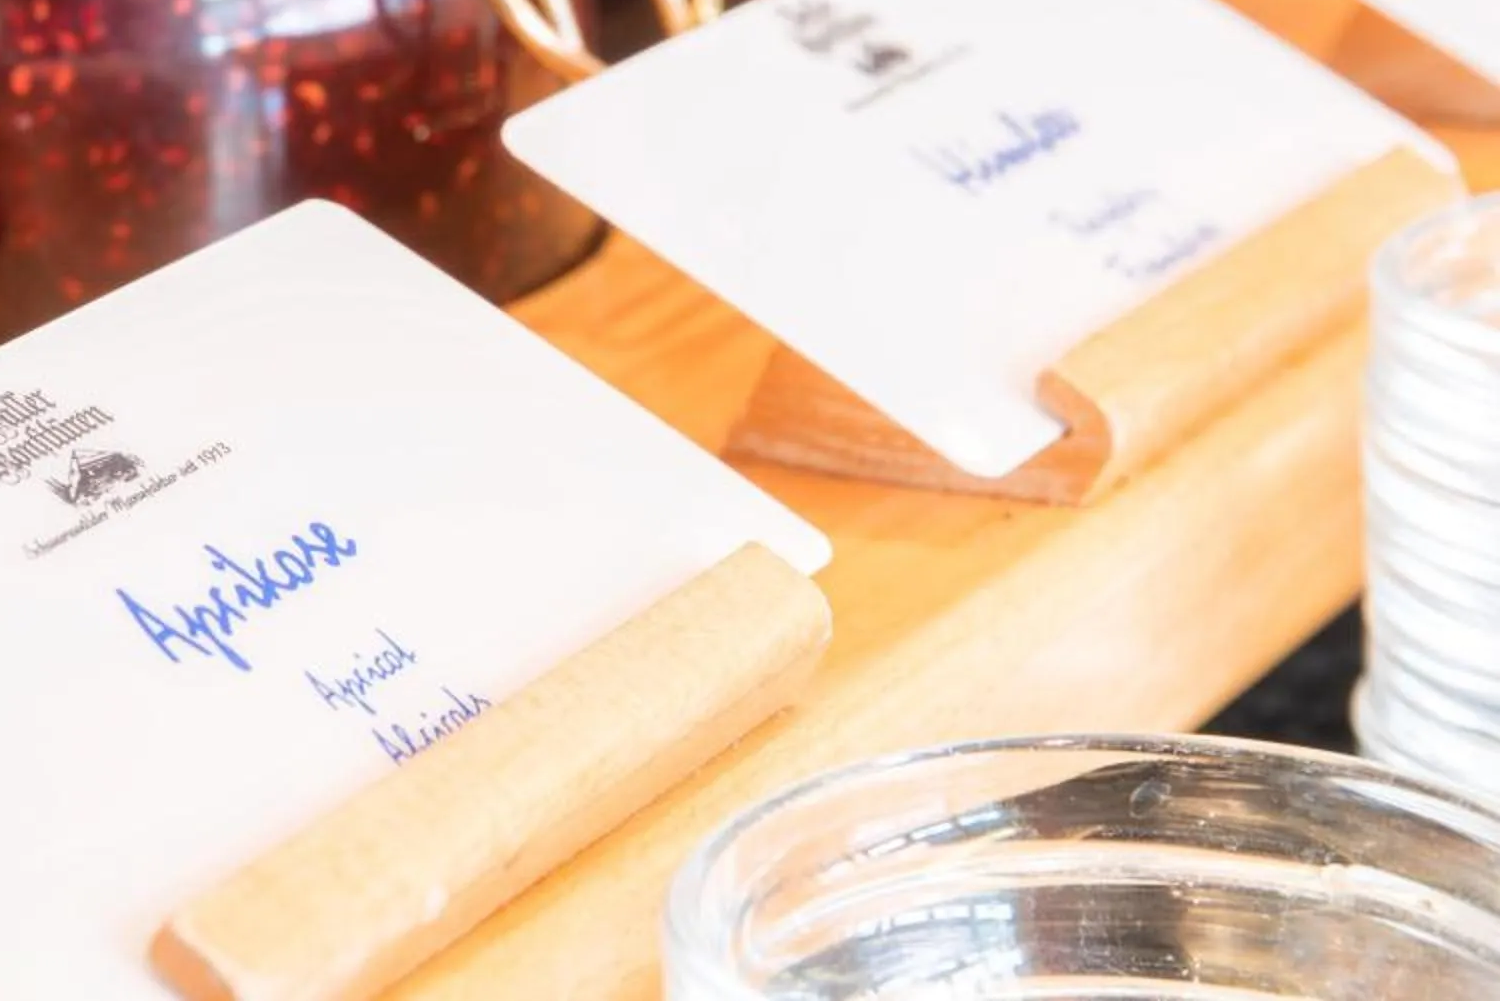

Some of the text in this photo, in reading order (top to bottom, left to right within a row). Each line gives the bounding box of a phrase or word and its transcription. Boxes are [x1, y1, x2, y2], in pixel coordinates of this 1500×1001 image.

[197, 441, 232, 467] 1913
[115, 521, 358, 673] Aprikose
[305, 627, 418, 716] Apricot
